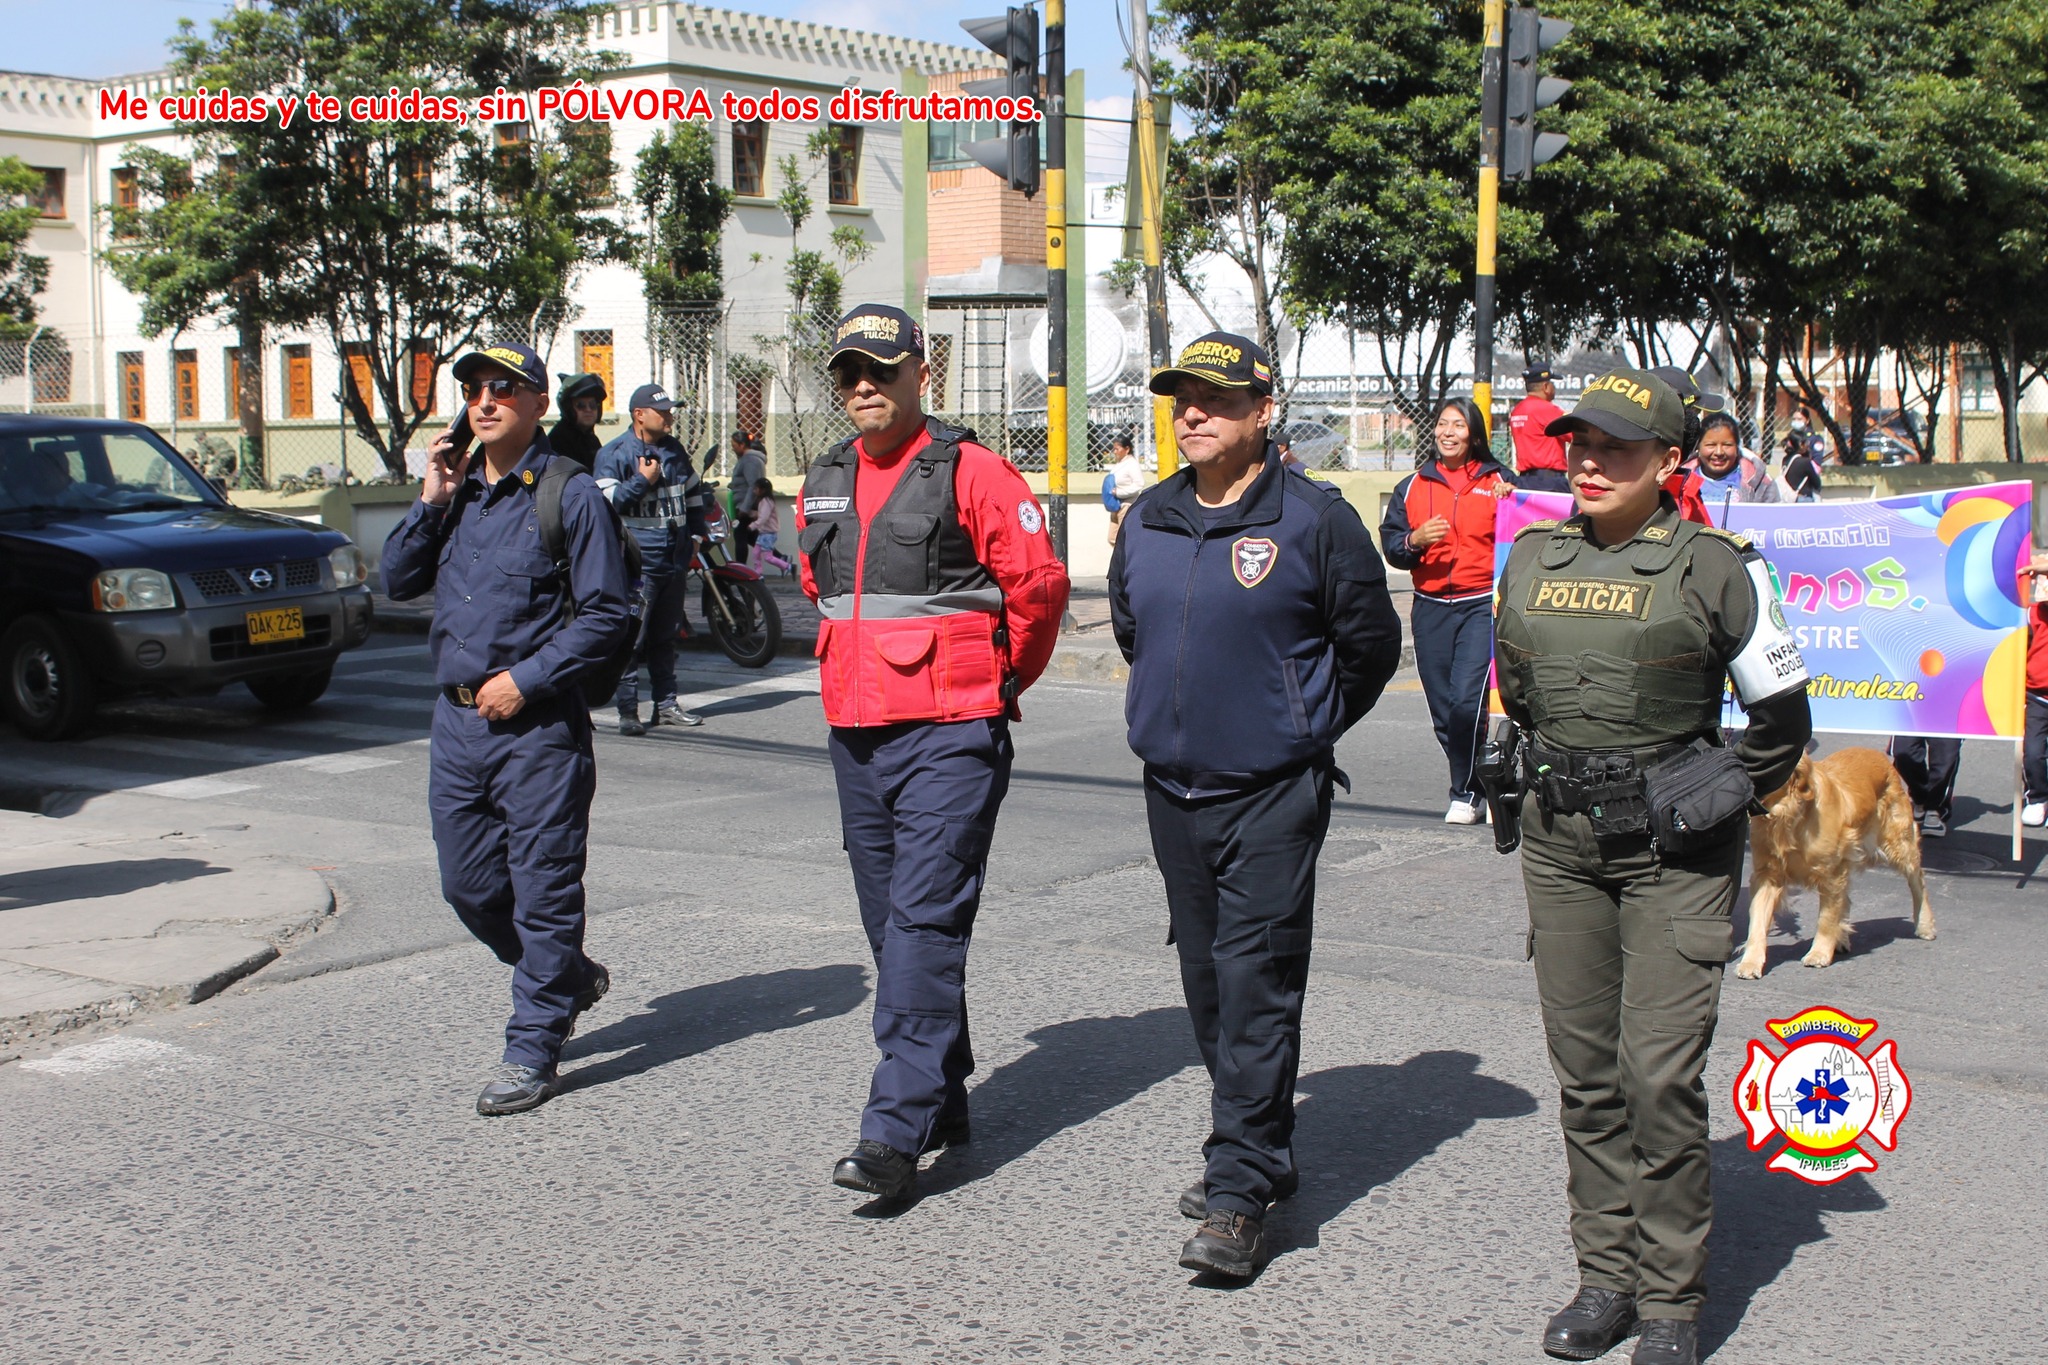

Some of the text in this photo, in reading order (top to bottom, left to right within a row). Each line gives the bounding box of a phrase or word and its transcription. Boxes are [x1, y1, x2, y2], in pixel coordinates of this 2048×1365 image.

[836, 315, 900, 344] BOMBEROS
[1496, 374, 1526, 390] Jos
[1774, 523, 1891, 549] INFANTIL
[1534, 587, 1634, 613] POLICIA
[276, 613, 301, 631] 225
[1791, 626, 1860, 650] STRE
